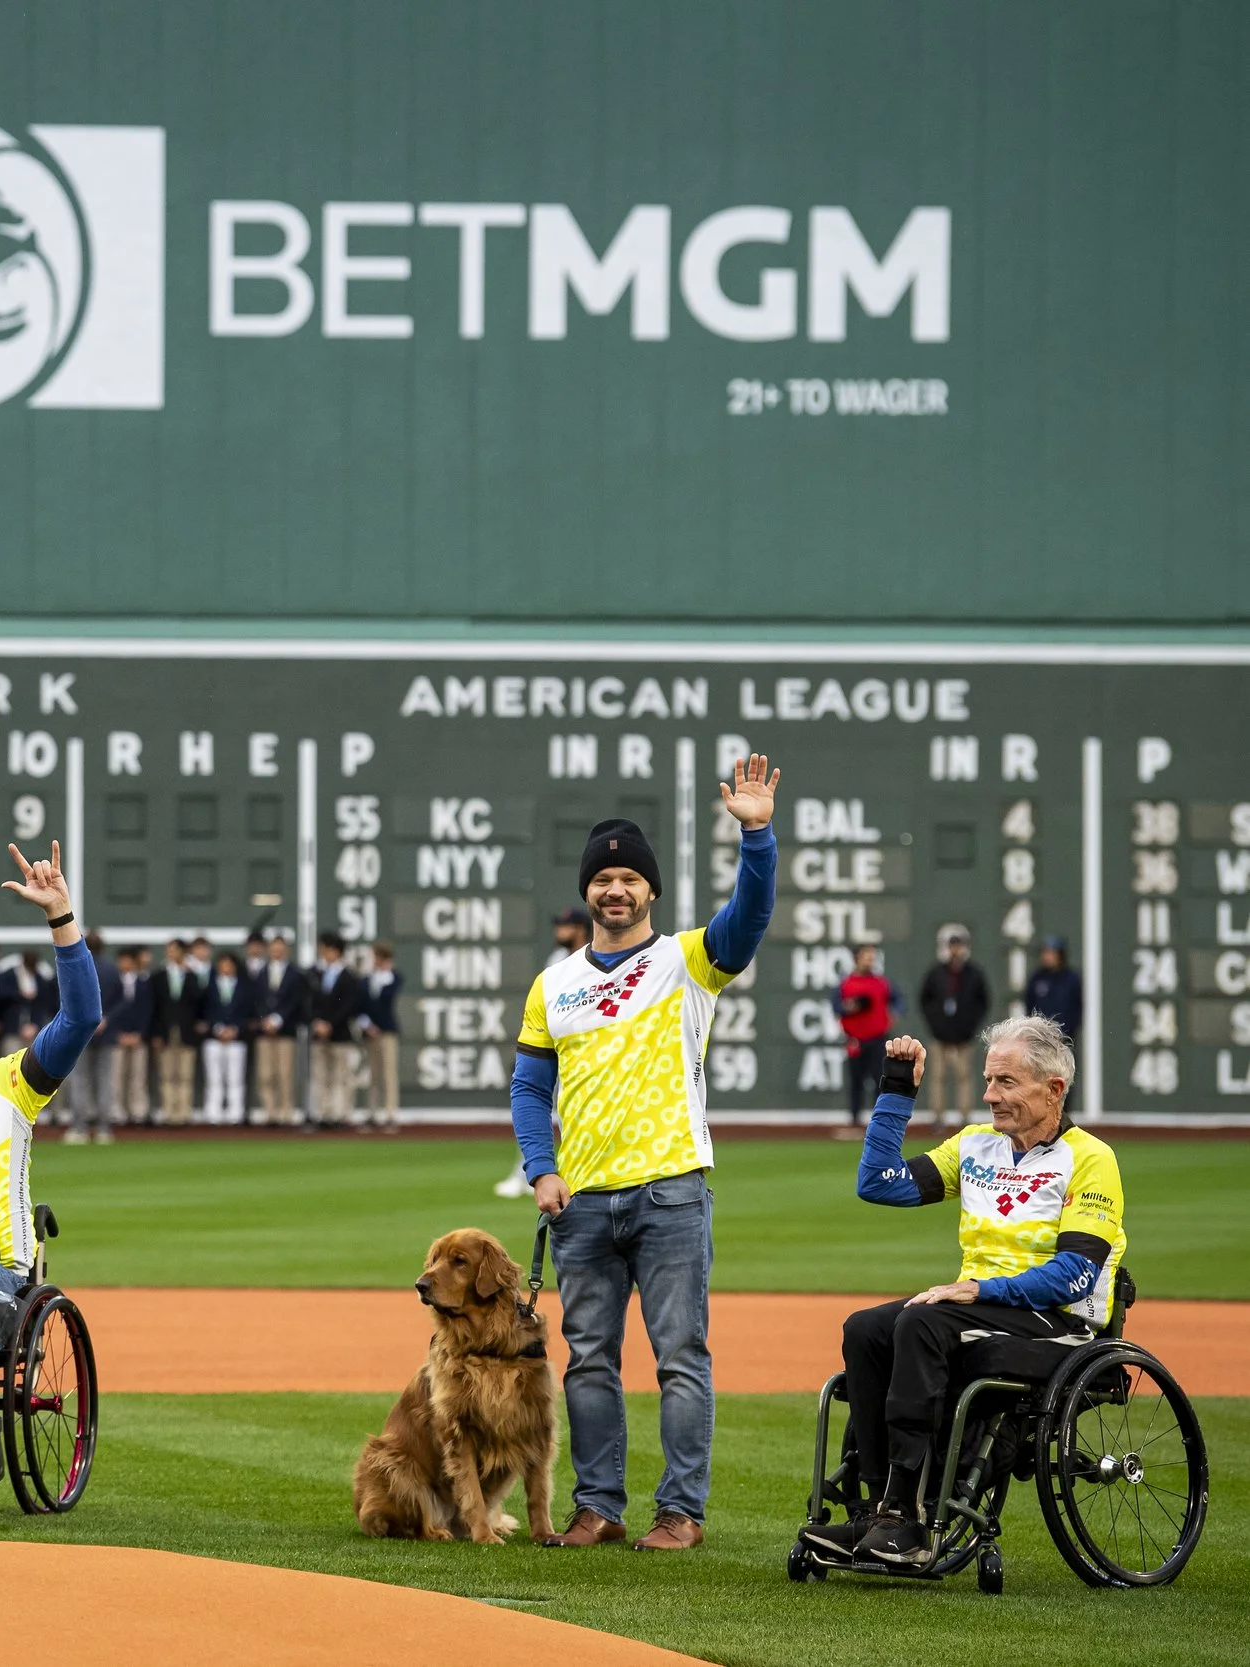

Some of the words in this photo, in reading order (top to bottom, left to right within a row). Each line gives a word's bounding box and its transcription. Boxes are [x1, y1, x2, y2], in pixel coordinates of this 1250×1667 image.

[209, 200, 950, 341] BETMGM
[786, 377, 830, 415] TO
[832, 377, 949, 416] WAGER
[400, 675, 707, 719] AMERICAN
[739, 678, 971, 722] LEAGUE
[7, 729, 59, 778] 10
[107, 731, 143, 776] R
[179, 730, 214, 777] H
[249, 732, 279, 777] E
[341, 732, 375, 778] P
[549, 734, 599, 779] IN
[618, 734, 653, 779] R
[716, 733, 751, 781] P
[929, 735, 980, 781] IN
[1001, 733, 1039, 782] R
[1137, 736, 1173, 784] P
[335, 795, 382, 842] 55
[430, 797, 494, 842] KC
[794, 798, 881, 844] BAL
[1002, 799, 1036, 845] 4
[335, 844, 382, 889] 40
[417, 845, 505, 890] NYY
[791, 848, 885, 893] CLE
[1002, 848, 1036, 895] 8
[337, 895, 378, 942] 51
[423, 896, 502, 942] CIN
[793, 900, 883, 944] STL
[1002, 900, 1036, 945] 4
[1217, 900, 1250, 946] L
[422, 946, 502, 990] MIN
[418, 997, 506, 1043] TEX
[713, 998, 758, 1042] 22
[417, 1045, 507, 1091] SEA
[711, 1047, 758, 1093] 59
[1217, 1049, 1250, 1095] L
[1080, 1192, 1114, 1207] Military
